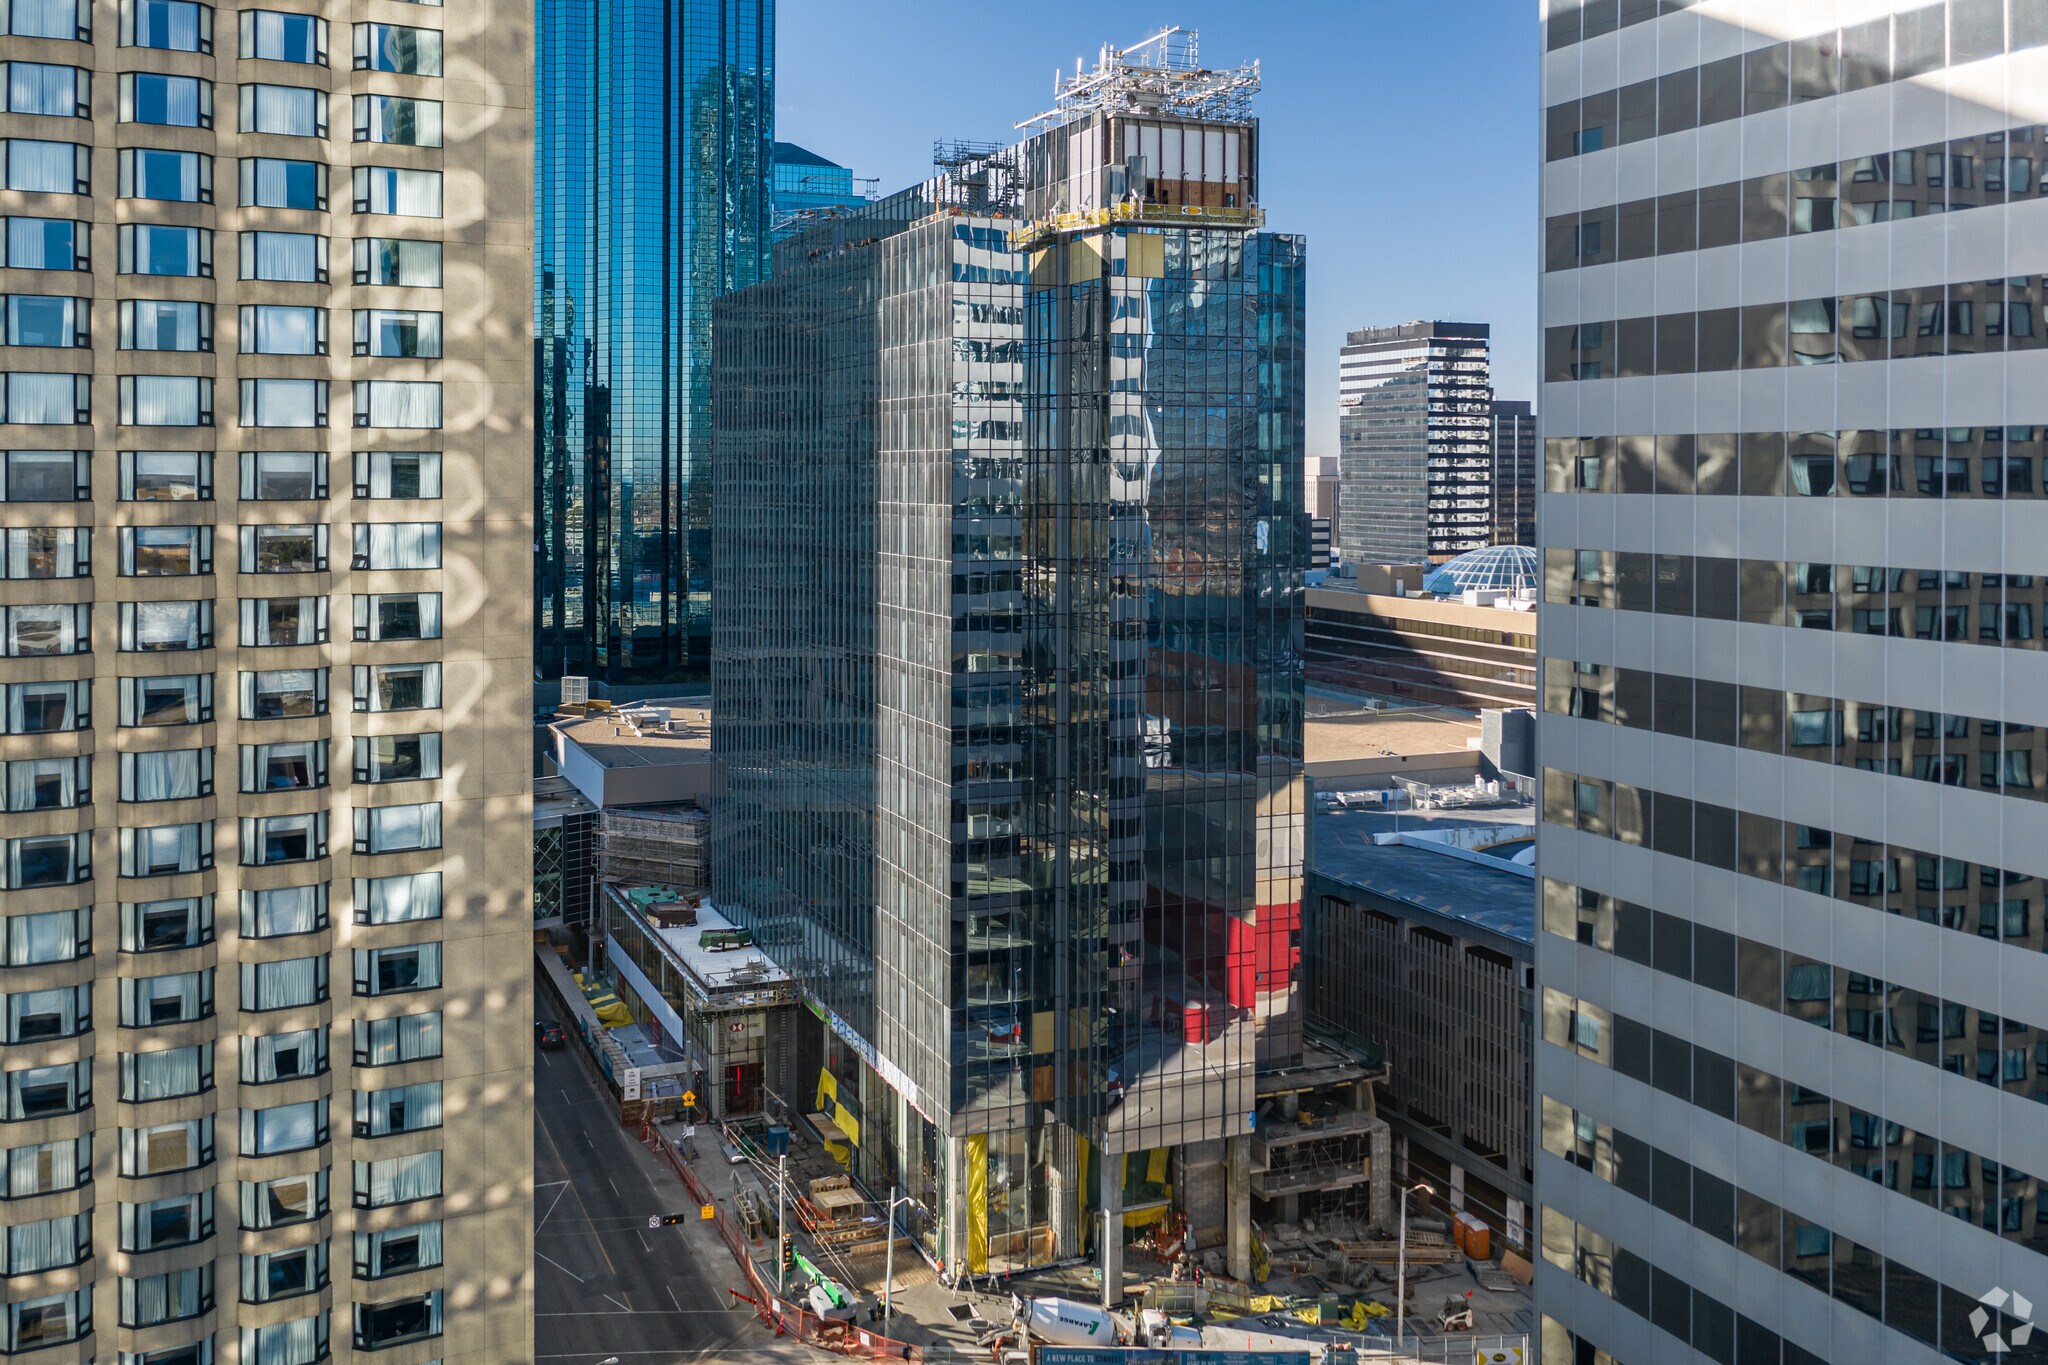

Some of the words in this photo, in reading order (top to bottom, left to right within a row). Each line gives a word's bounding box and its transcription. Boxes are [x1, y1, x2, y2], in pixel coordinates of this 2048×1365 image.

[1059, 1316, 1092, 1328] LAFARGE
[1046, 1354, 1051, 1362] A
[1052, 1354, 1066, 1362] NEW
[1067, 1354, 1086, 1363] PLACE
[1087, 1355, 1095, 1363] TO
